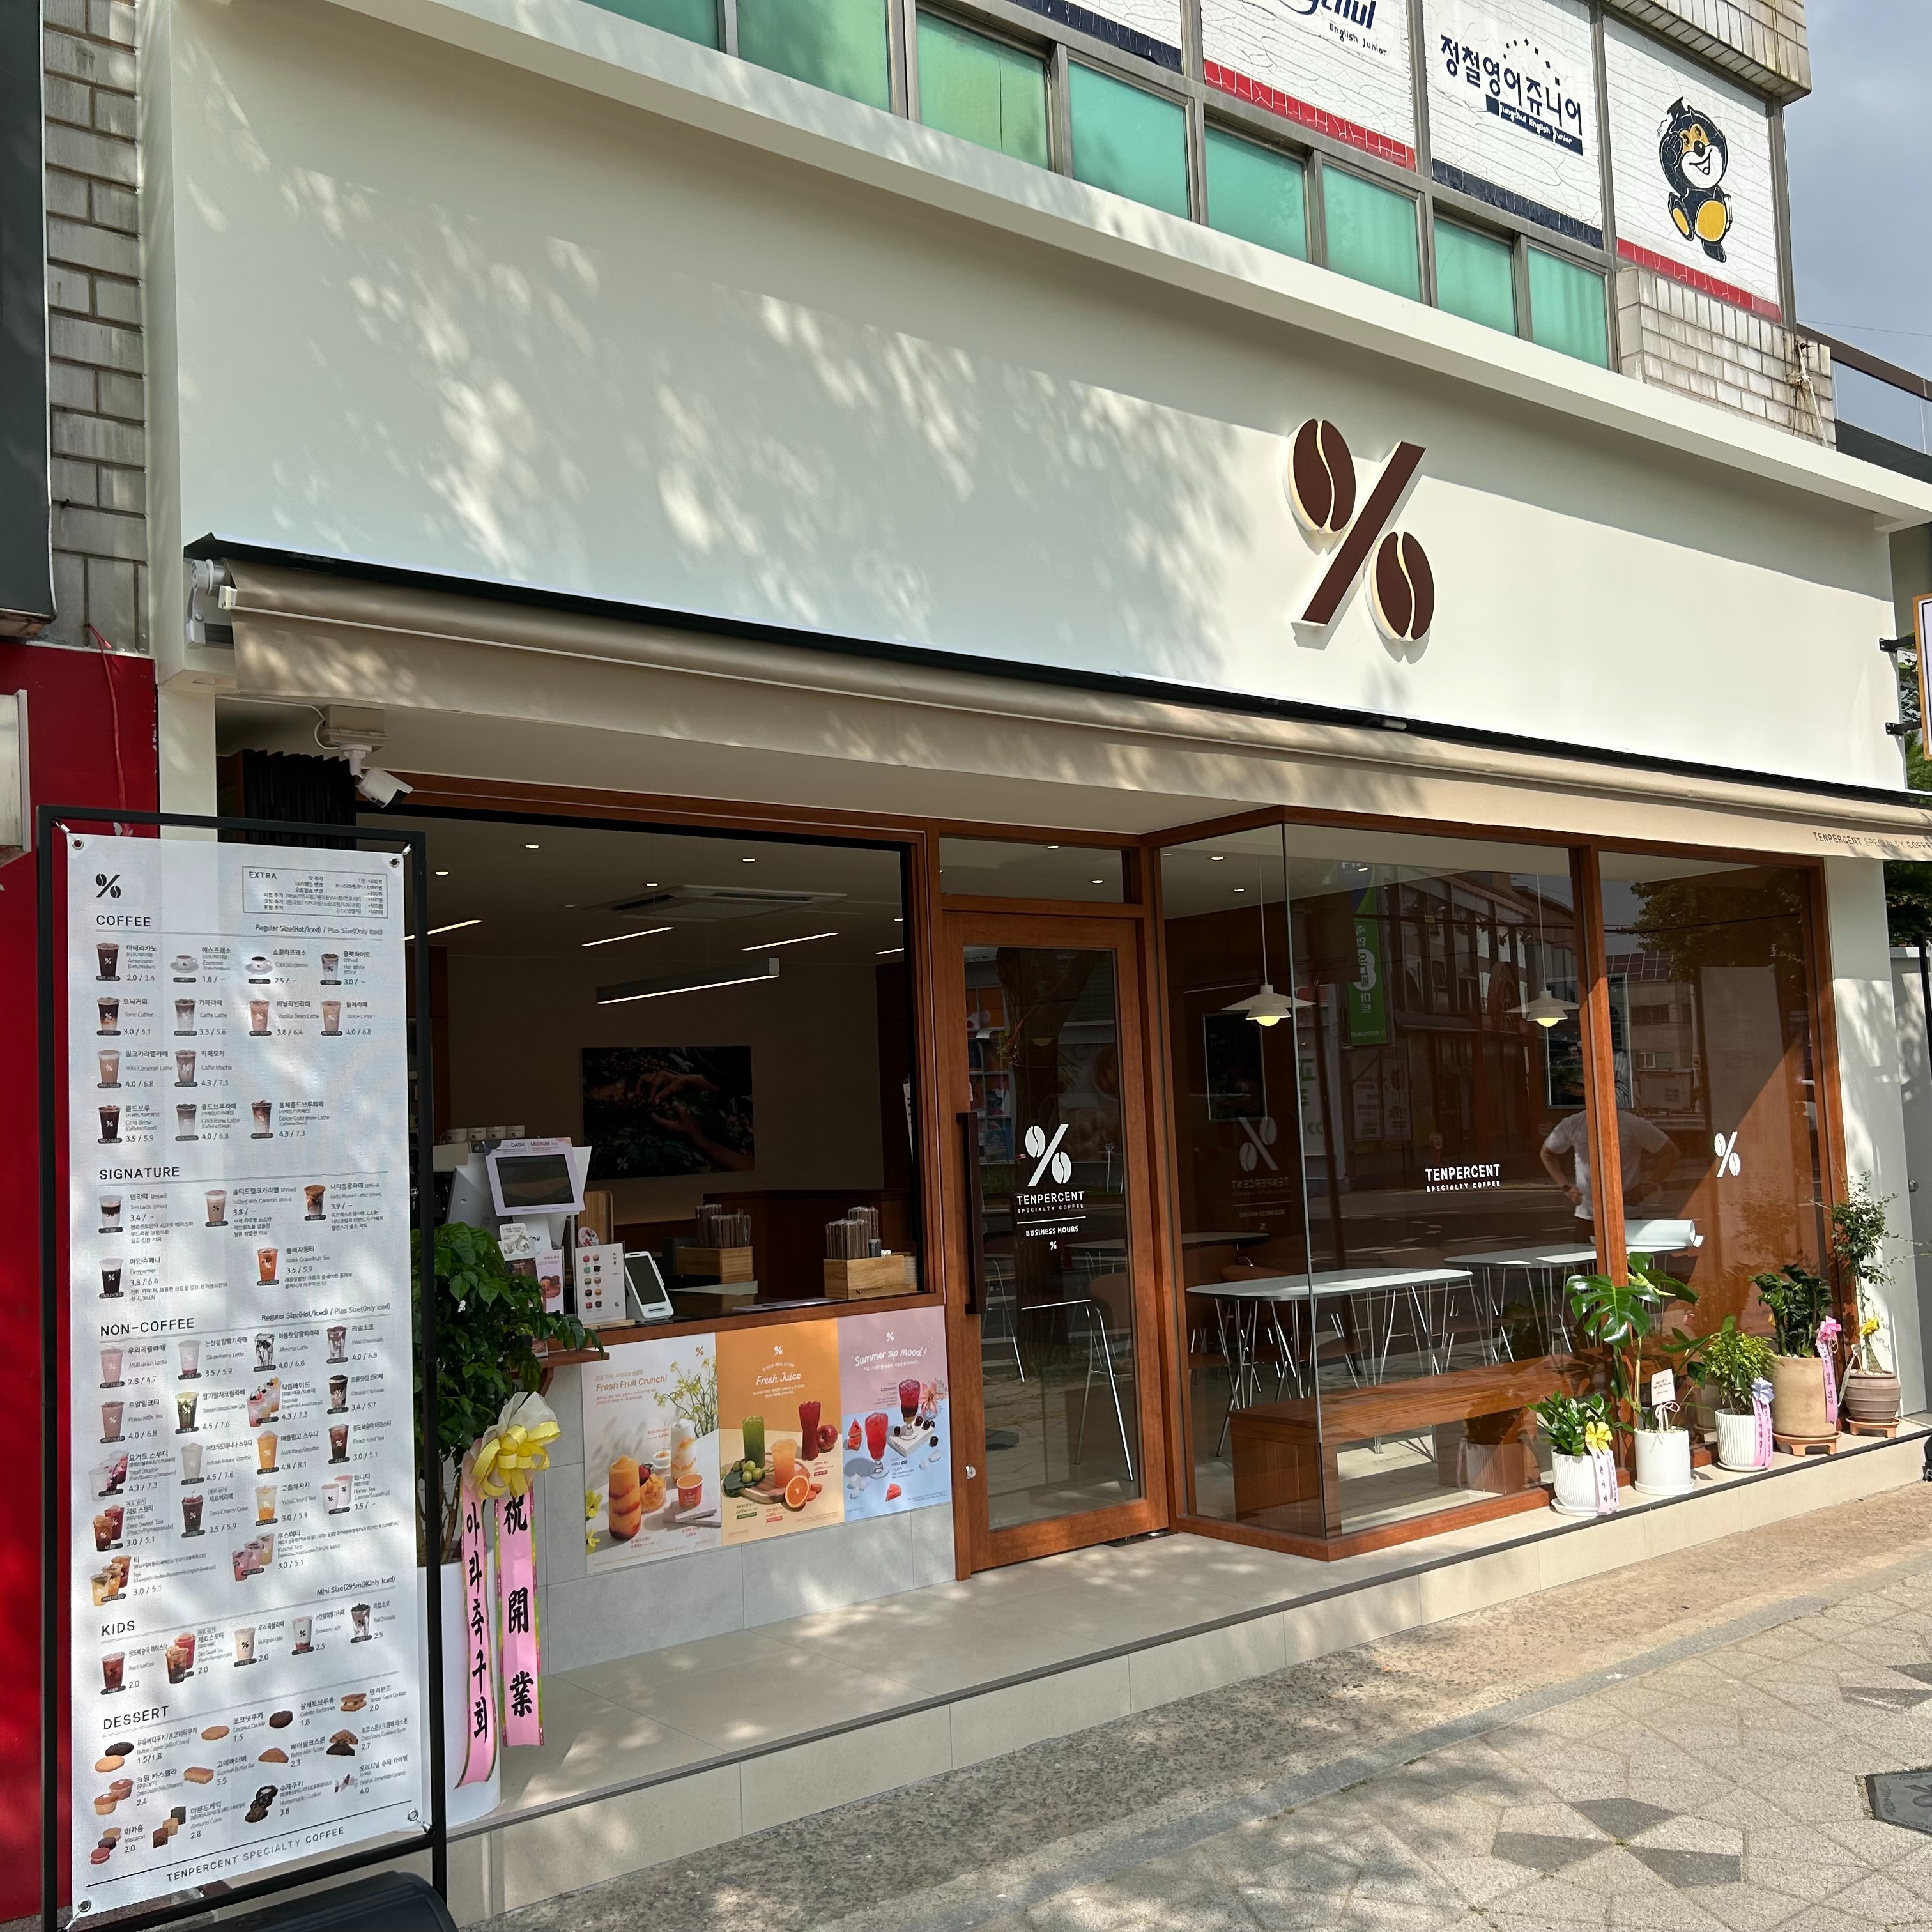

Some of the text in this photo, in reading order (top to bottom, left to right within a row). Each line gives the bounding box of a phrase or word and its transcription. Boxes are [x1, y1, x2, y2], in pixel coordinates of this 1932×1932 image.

[1330, 22, 1388, 56] English Junior
[1441, 34, 1582, 136] 정철영어쥬니어
[1529, 117, 1551, 134] English
[1813, 832, 1932, 849] TENPERCENT SPECIALTY COFFE
[249, 871, 277, 880] EXTRA
[96, 915, 151, 926] COFFEE
[100, 1167, 180, 1180] SIGNATURE
[1425, 1164, 1501, 1181] TENPERCENT
[1426, 1183, 1468, 1192] SPECIALTY
[1016, 1191, 1084, 1206] TENPERCENT
[1026, 1225, 1078, 1237] BUSINESS HOURS
[100, 1317, 194, 1337] NON-COFFEE
[855, 1351, 887, 1367] Summer
[887, 1348, 898, 1360] sip
[900, 1347, 923, 1357] mood
[596, 1382, 618, 1392] Fresh
[620, 1379, 636, 1388] Fruit
[638, 1374, 668, 1386] Crunch!
[756, 1372, 802, 1386] Fresh Juice
[129, 1450, 168, 1462] 요거트 스무디
[317, 1587, 330, 1595] Mini
[503, 1494, 534, 1719] 祝開業
[102, 1620, 135, 1636] KIDS
[466, 1501, 489, 1745] 아라축구회
[103, 1705, 170, 1730] DESSERT
[124, 1825, 144, 1834] 마카롱
[167, 1826, 345, 1882] TENPERCENT SPECIALTY COFFEE
